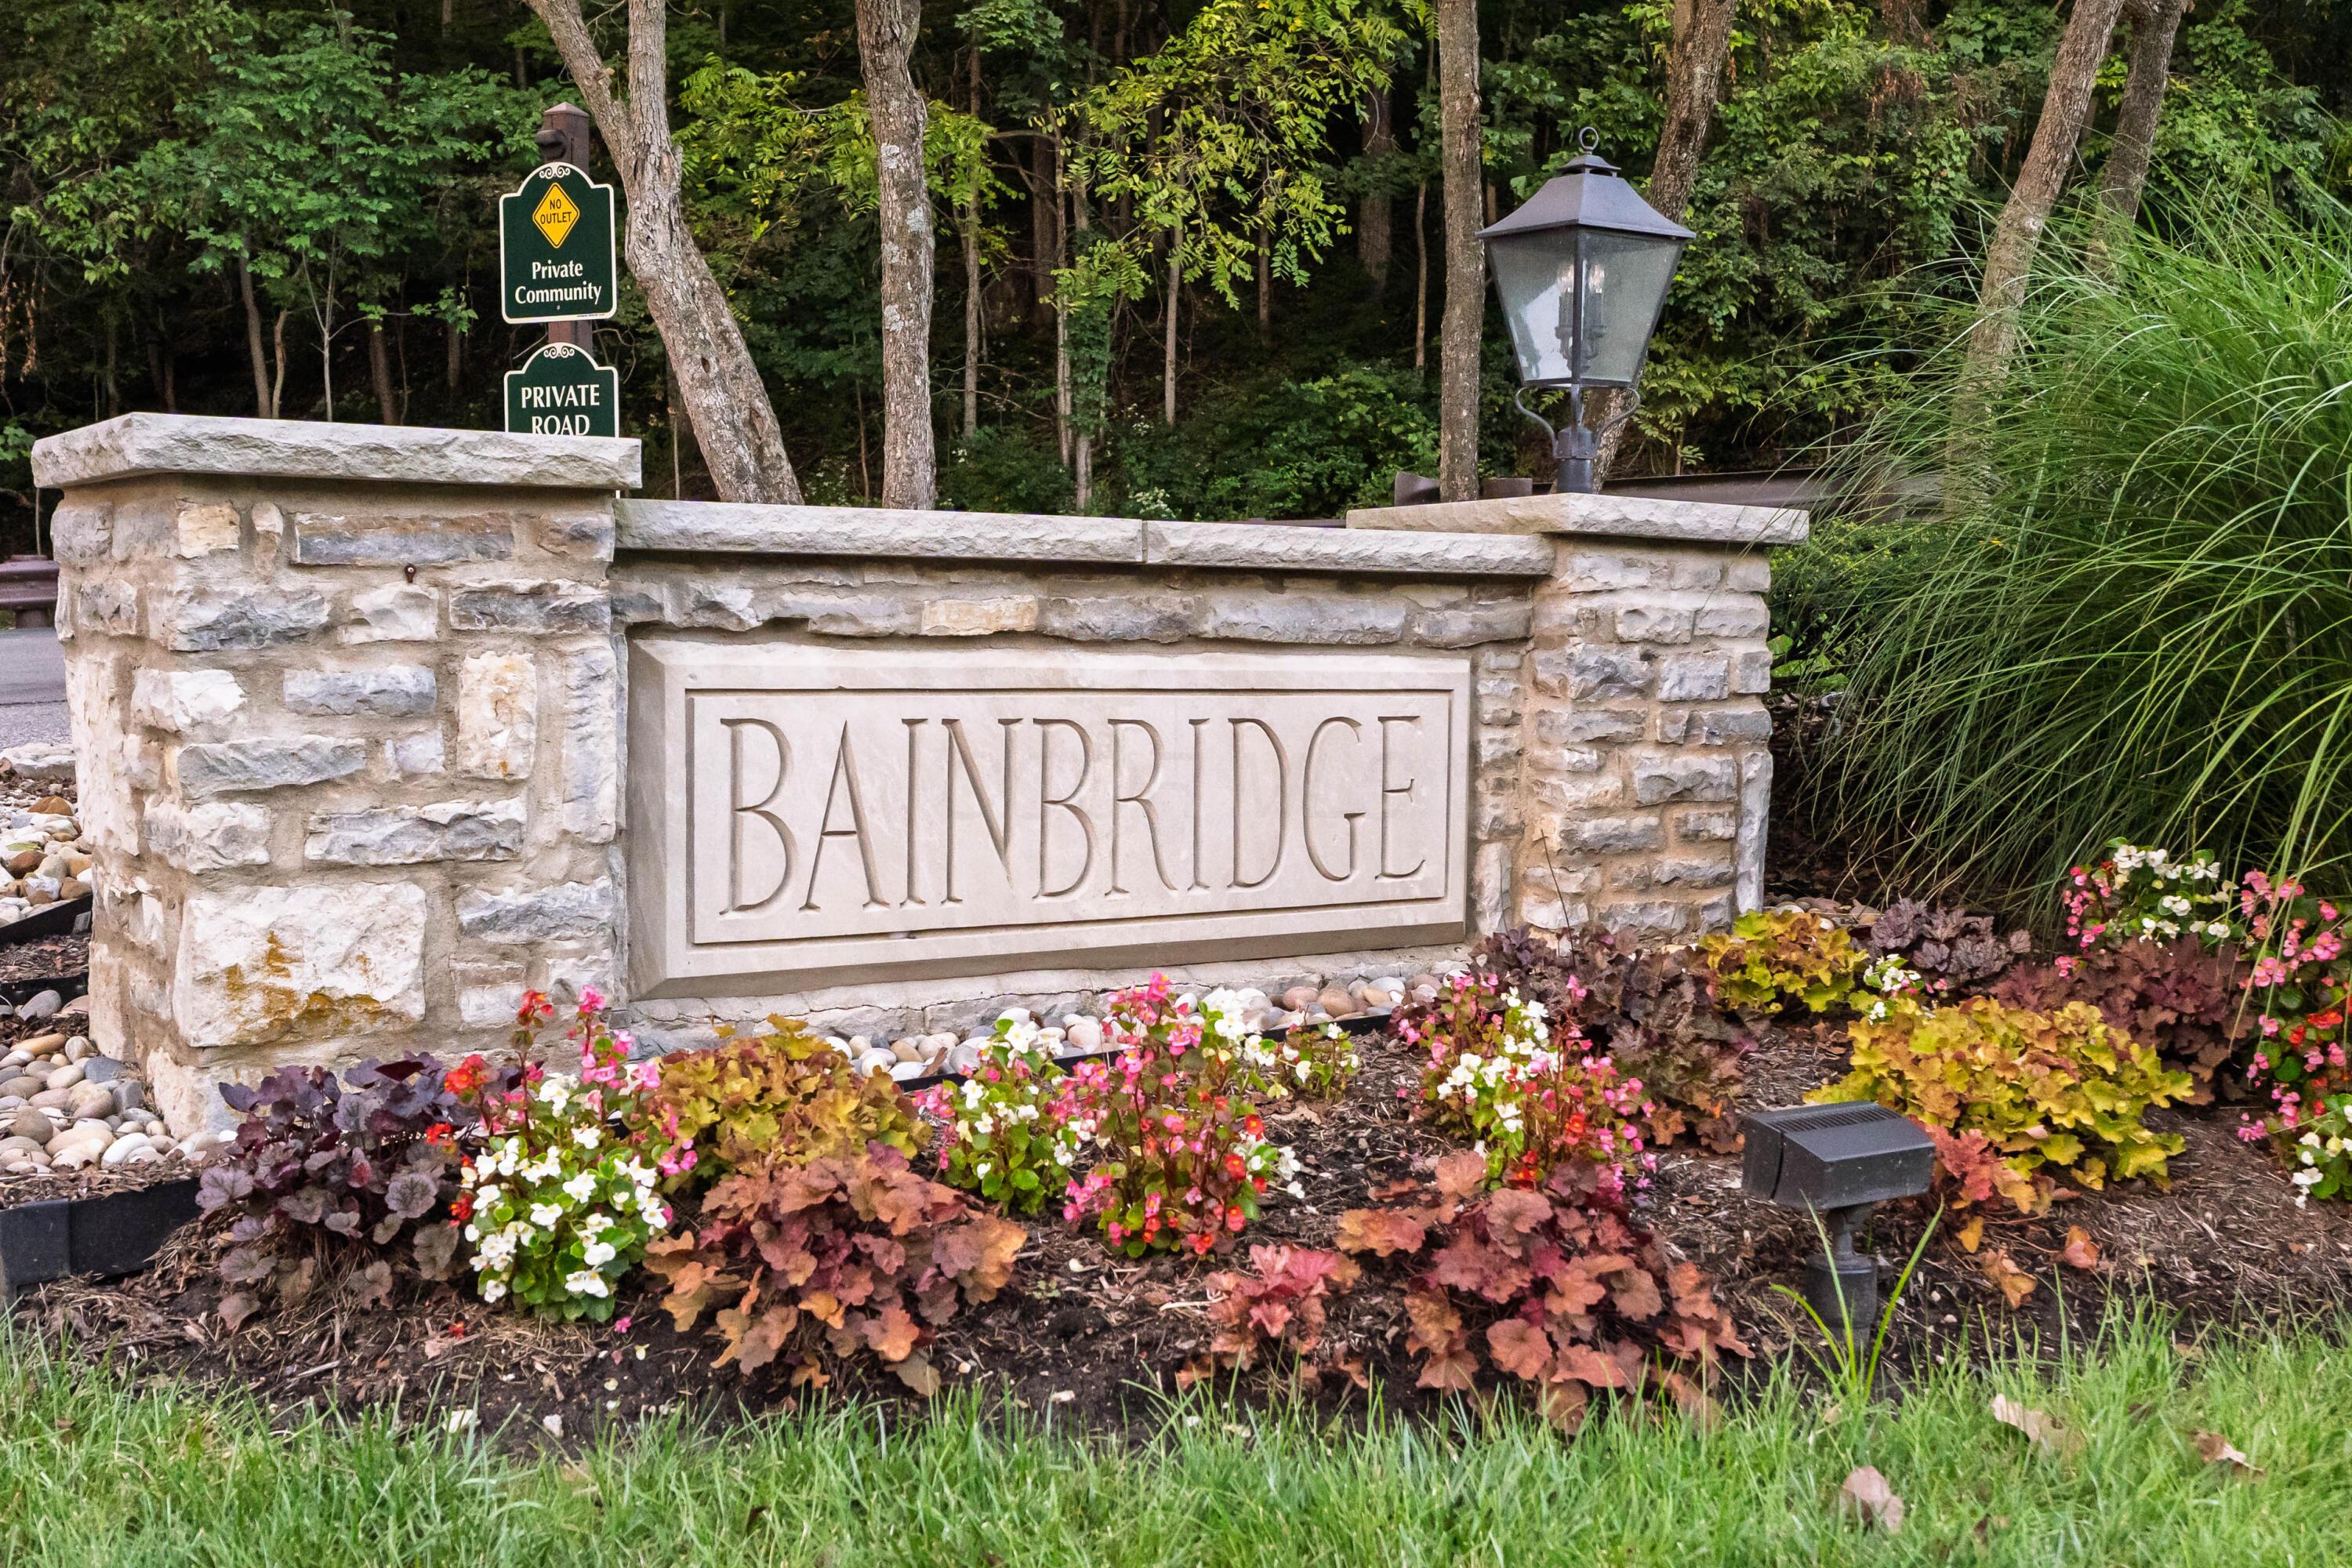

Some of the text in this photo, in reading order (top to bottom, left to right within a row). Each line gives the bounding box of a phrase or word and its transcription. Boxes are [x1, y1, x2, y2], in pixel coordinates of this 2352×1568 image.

[550, 198, 562, 210] NO
[539, 212, 572, 224] OUTLET
[532, 260, 583, 280] Private
[515, 281, 602, 305] Community
[521, 384, 601, 408] PRIVATE
[532, 414, 590, 436] ROAD
[718, 715, 1426, 916] BAINBRIDGE
